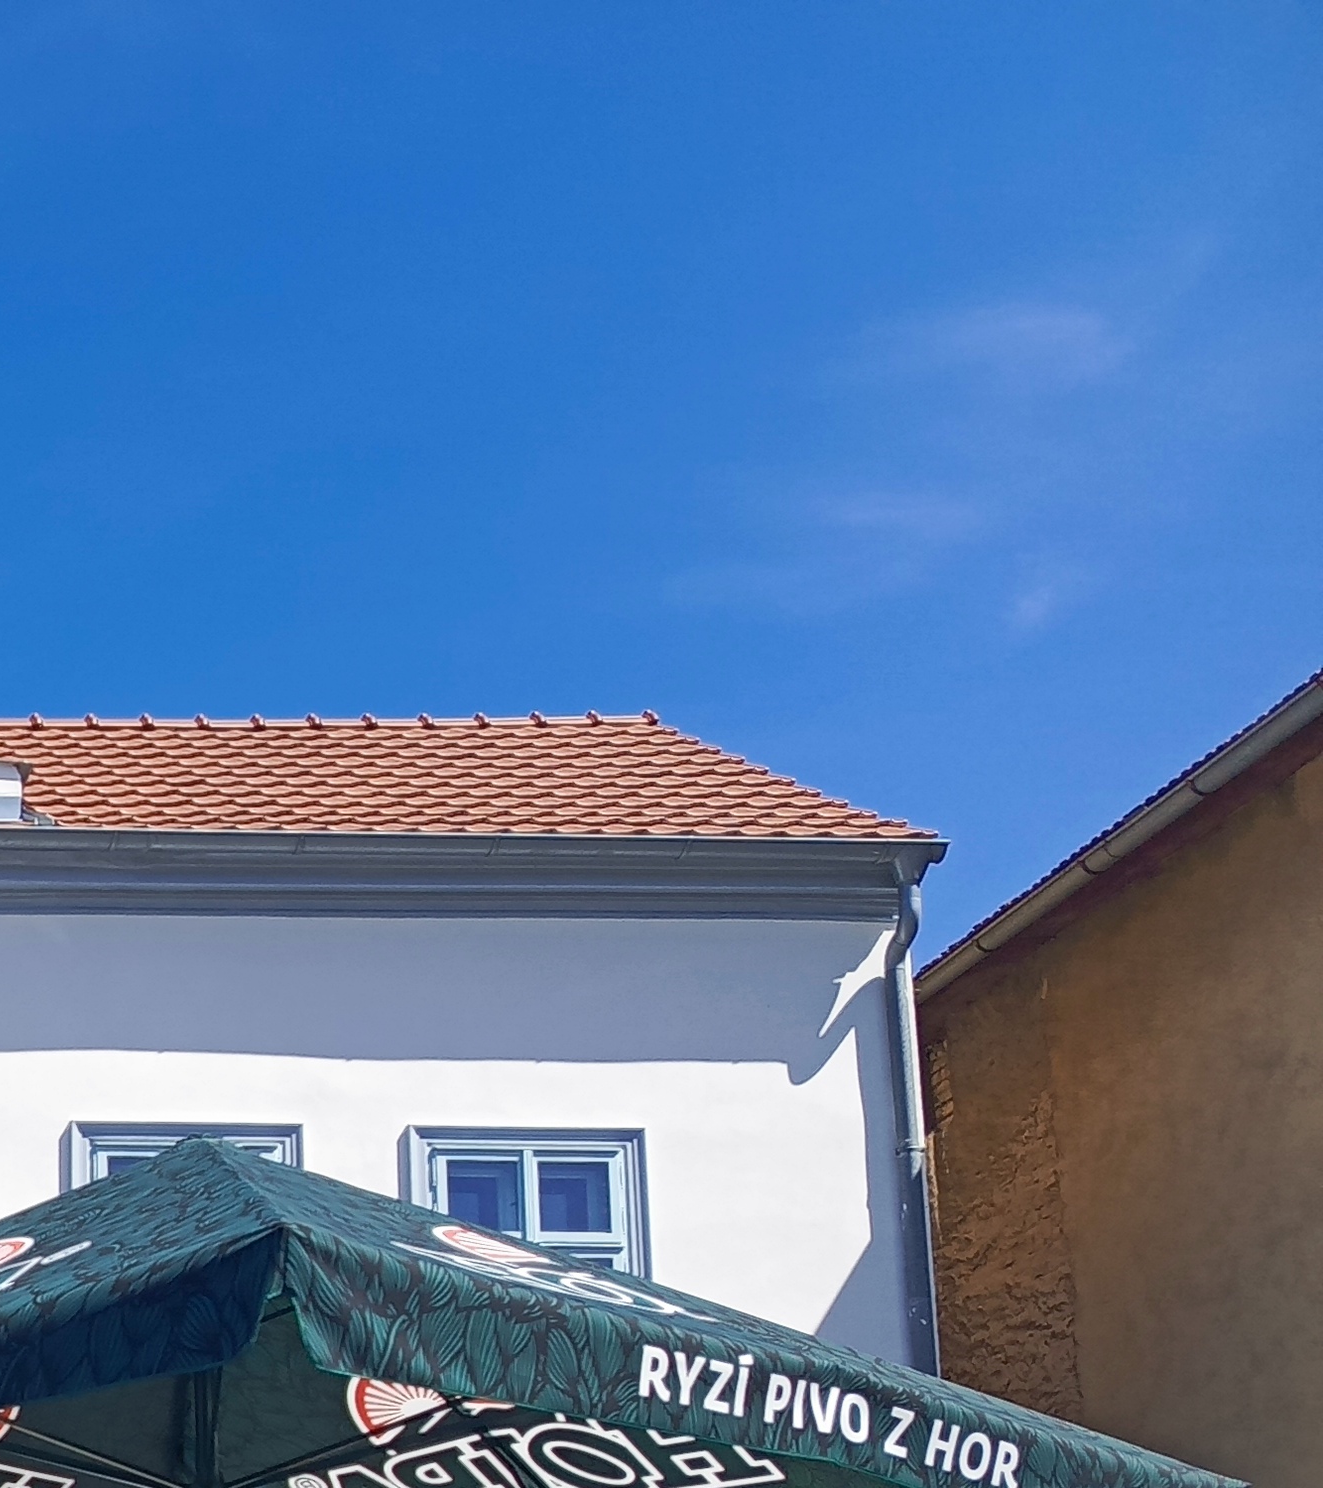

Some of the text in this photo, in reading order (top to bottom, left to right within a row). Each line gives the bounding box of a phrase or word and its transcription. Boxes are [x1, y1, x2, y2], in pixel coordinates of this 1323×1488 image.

[639, 1344, 754, 1417] RYZÍ
[763, 1374, 869, 1443] PIVO
[883, 1406, 915, 1459] Z
